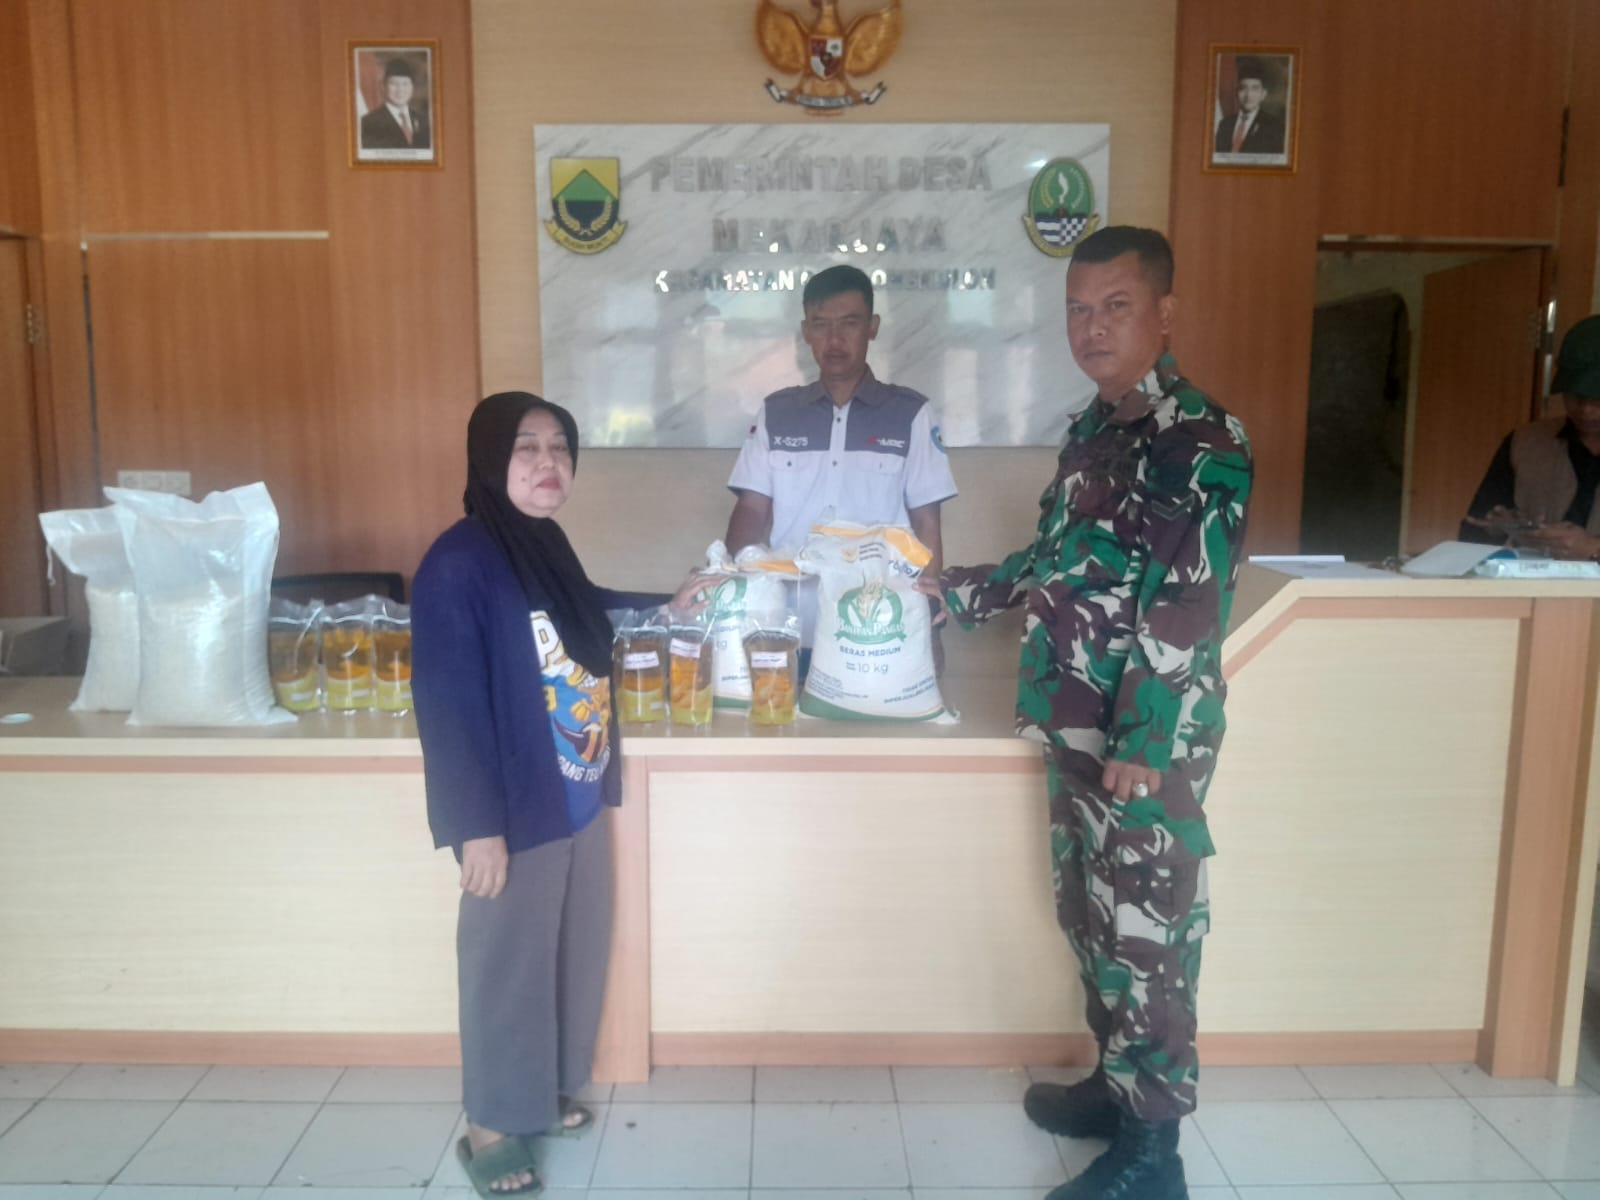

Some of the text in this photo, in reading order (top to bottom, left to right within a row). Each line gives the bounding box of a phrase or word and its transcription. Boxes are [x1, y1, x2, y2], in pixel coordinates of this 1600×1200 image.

[651, 156, 992, 192] PEMERINTAH DESA
[867, 646, 901, 657] MEDIUM
[858, 662, 870, 673] 10
[873, 662, 889, 675] kg
